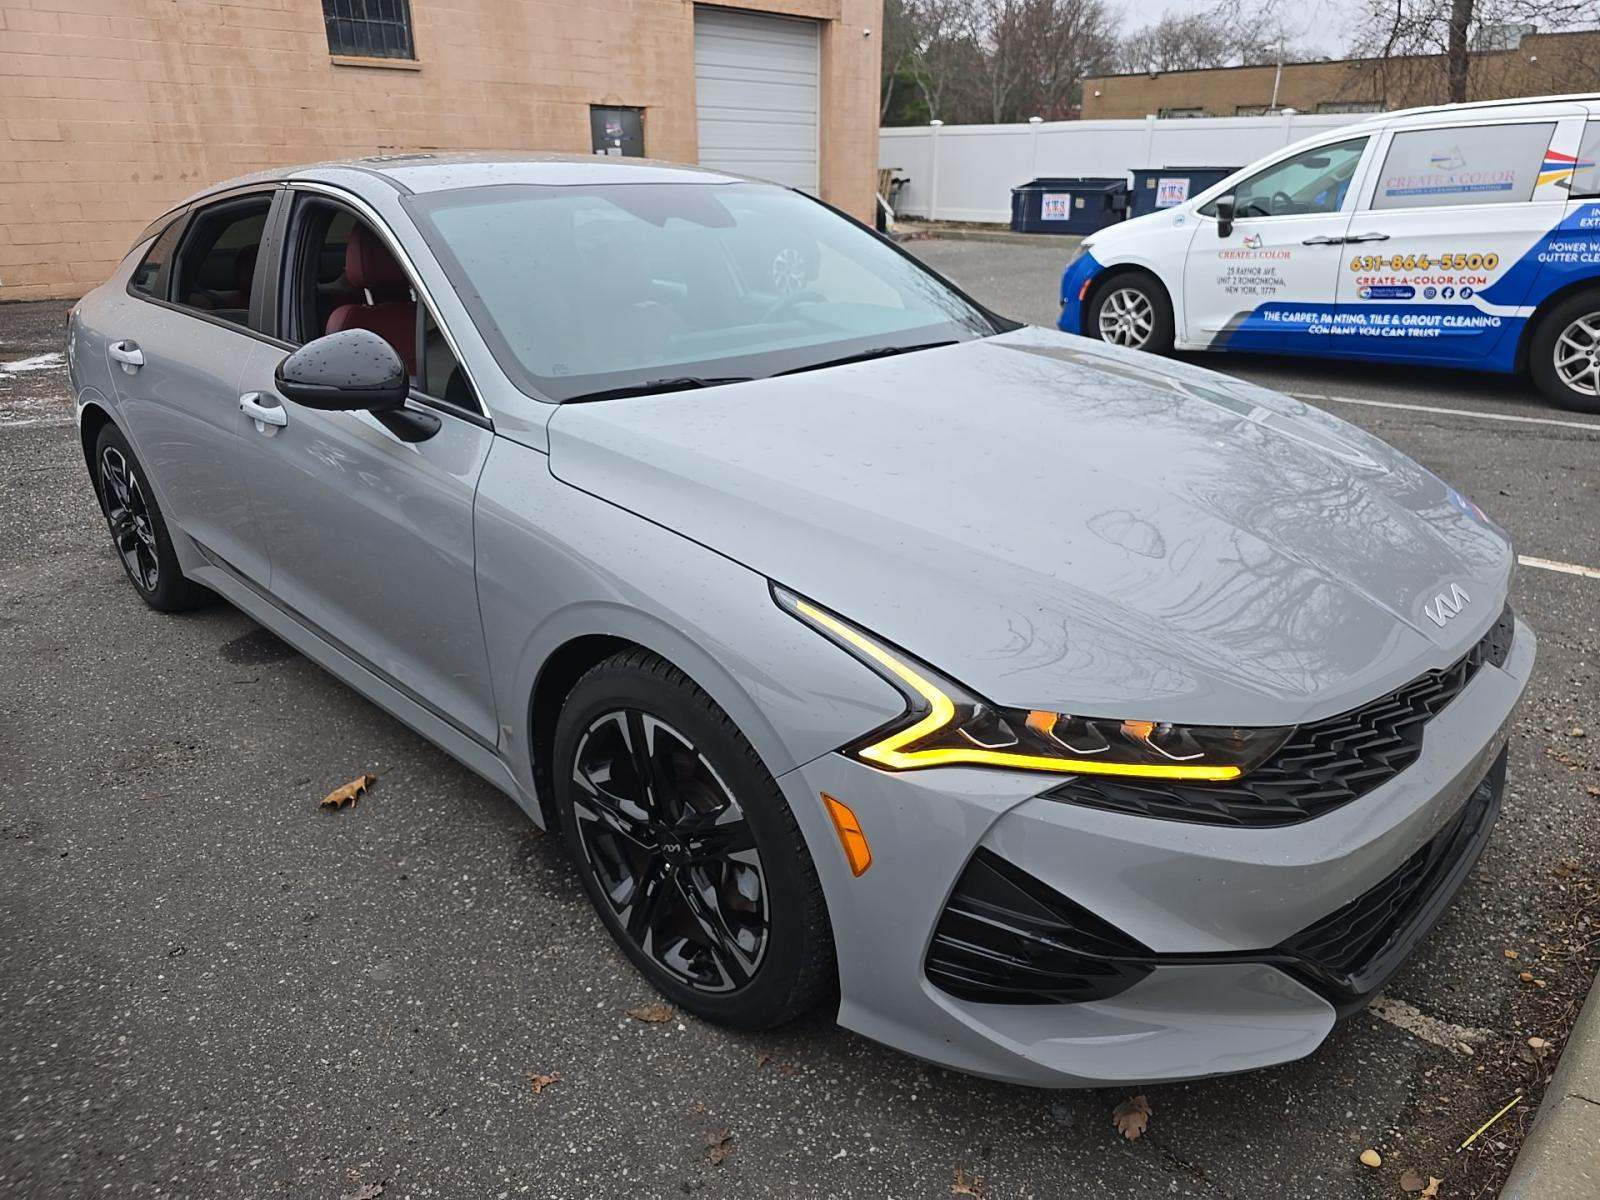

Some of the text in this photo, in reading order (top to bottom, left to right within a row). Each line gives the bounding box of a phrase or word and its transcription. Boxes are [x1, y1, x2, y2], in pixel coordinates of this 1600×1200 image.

[1458, 169, 1516, 184] COLOR
[1218, 250, 1250, 260] CREATE
[1259, 250, 1292, 260] COLOR
[1538, 252, 1578, 262] GUTTER
[1350, 253, 1499, 272] 631-864-5500
[1217, 276, 1232, 286] UNIT
[1356, 276, 1487, 286] CREATE-A-COLOR.COM
[1225, 286, 1239, 295] NEW
[1264, 311, 1281, 321] THE
[1320, 313, 1367, 325] PANTING,
[1370, 314, 1391, 325] TILE
[1391, 314, 1400, 325] &
[1402, 315, 1442, 326] GROUT
[1443, 316, 1501, 327] CLEANING
[1359, 326, 1381, 336] YOU
[1381, 327, 1406, 337] CAN
[1408, 327, 1440, 338] TRUST
[1424, 582, 1471, 629] KIA
